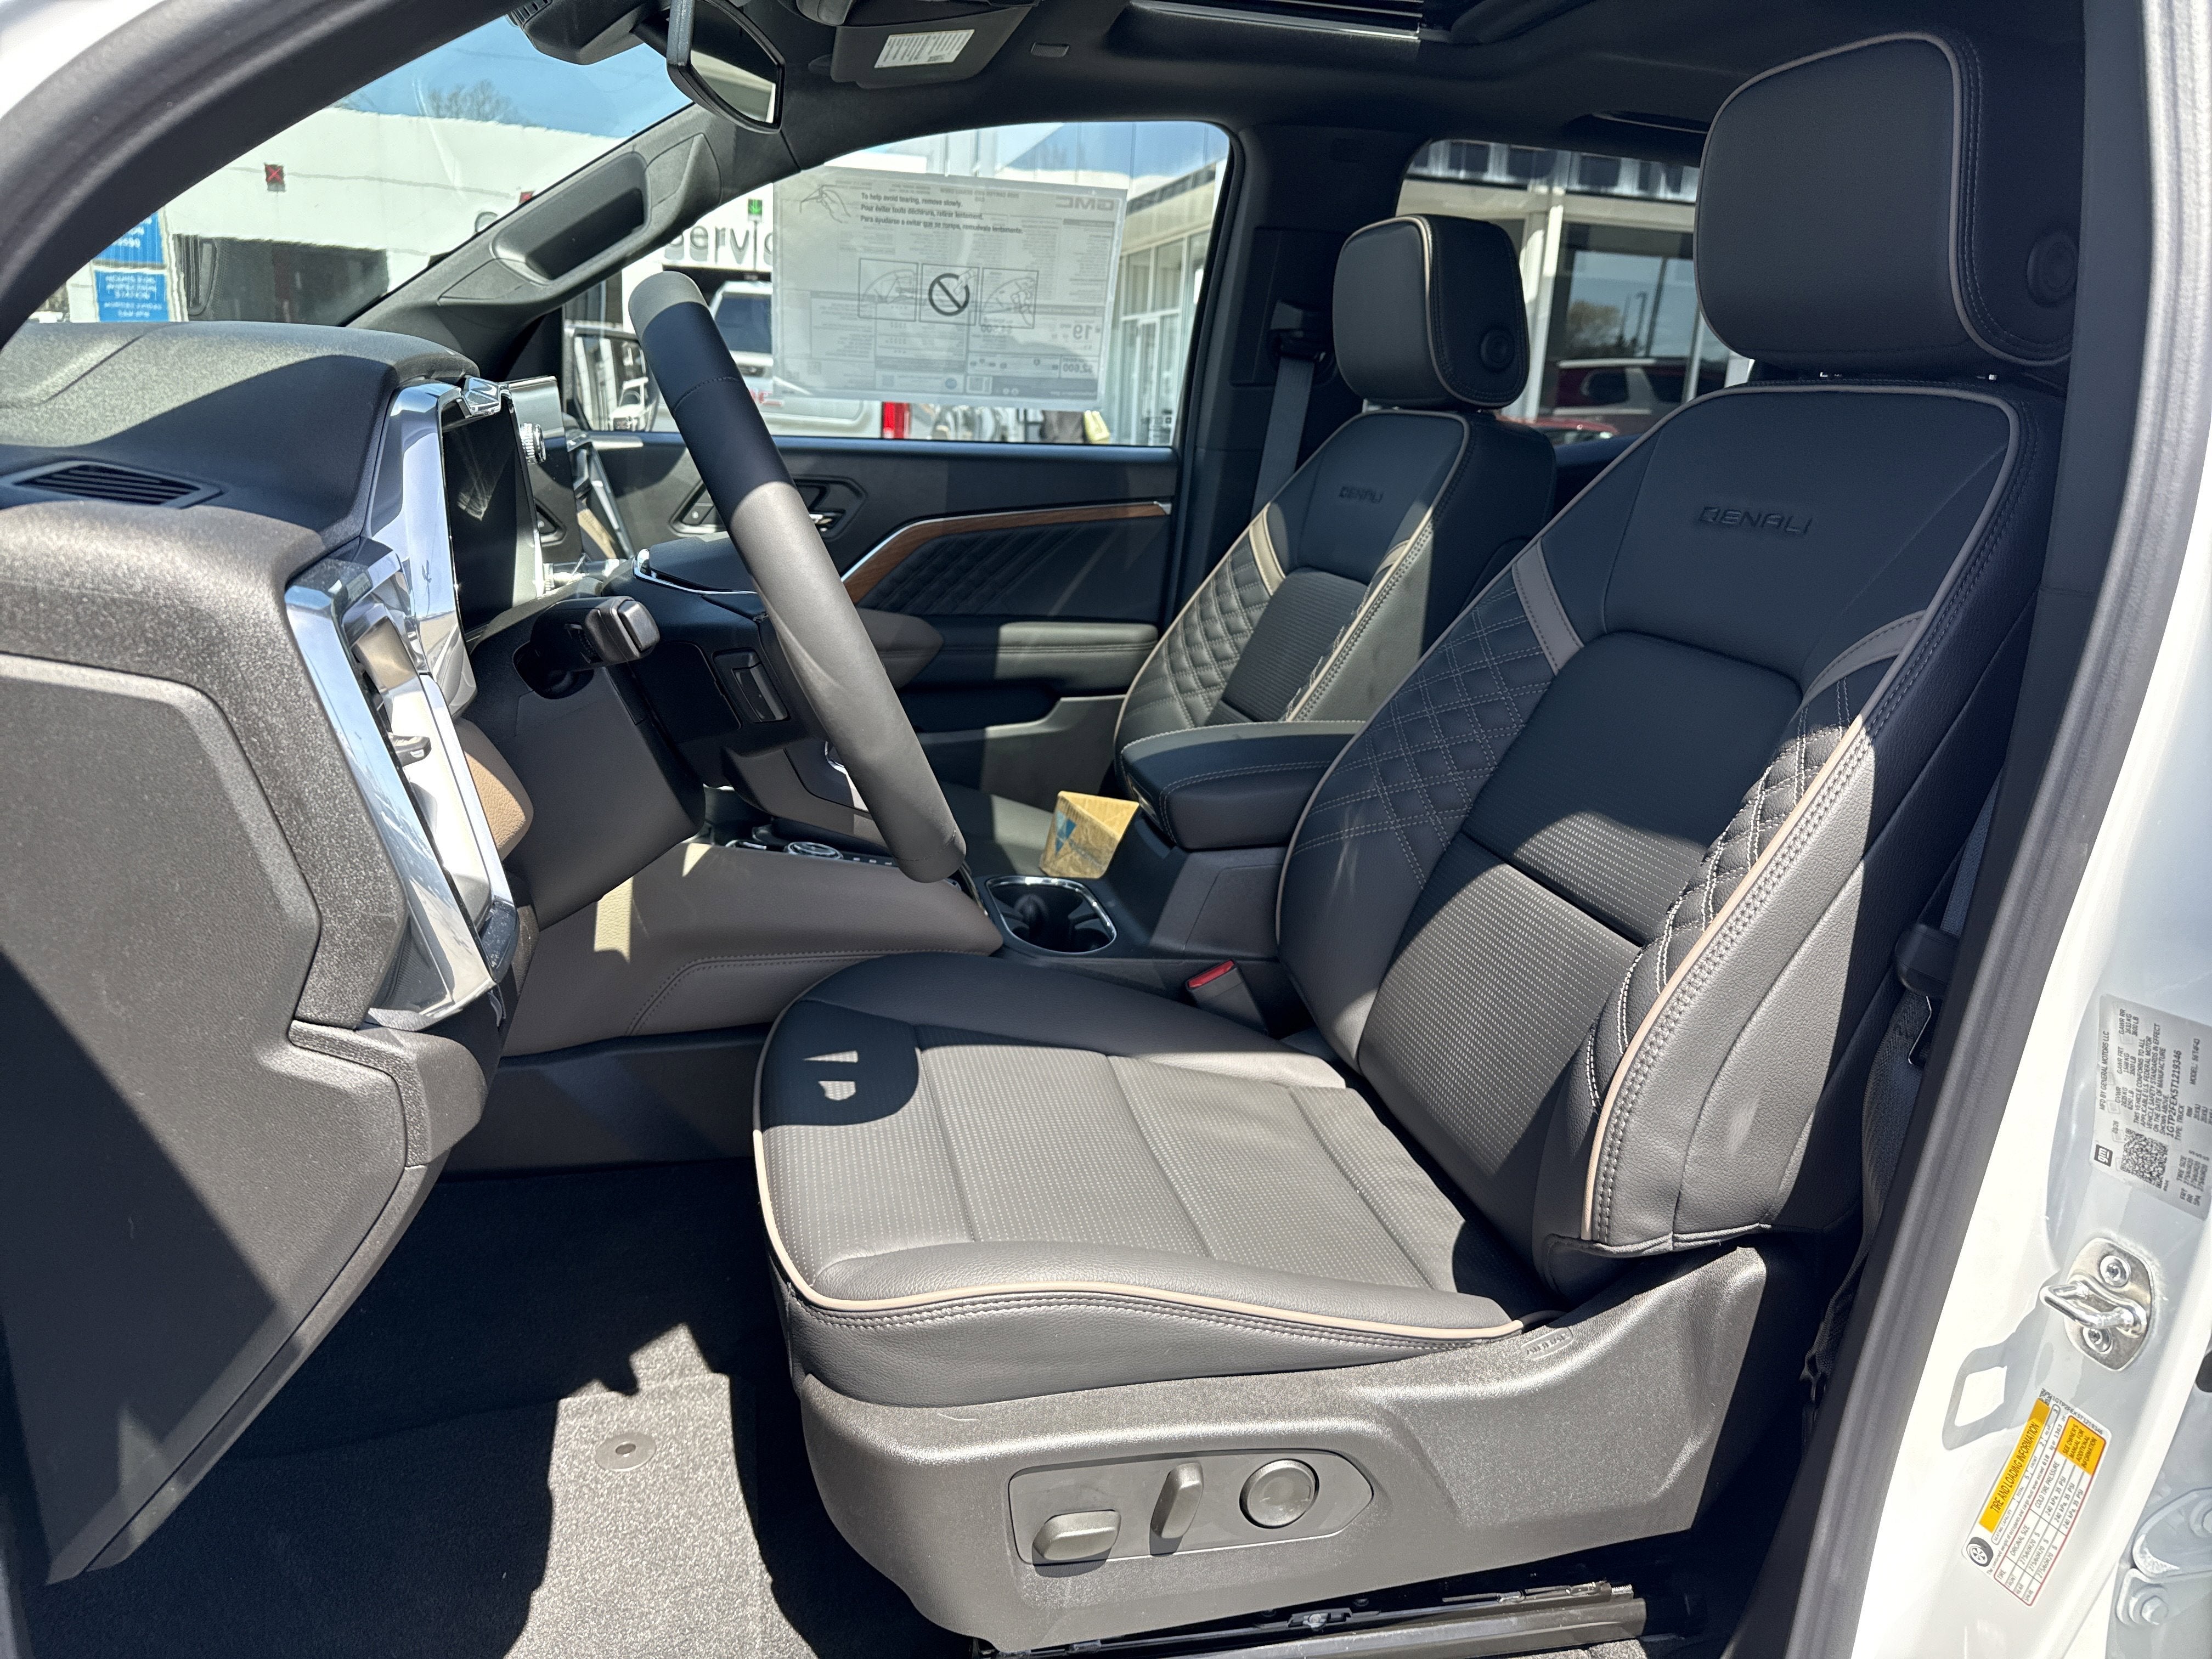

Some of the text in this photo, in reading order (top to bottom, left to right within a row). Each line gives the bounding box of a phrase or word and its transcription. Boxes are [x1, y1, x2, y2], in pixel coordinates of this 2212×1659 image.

[870, 193, 882, 202] help
[1698, 505, 1813, 535] DENALI
[2119, 1008, 2125, 1018] RR
[2125, 1012, 2132, 1022] KG
[2132, 1015, 2138, 1024] LB
[2123, 1052, 2130, 1062] KG
[2129, 1055, 2136, 1064] LB
[2137, 1048, 2145, 1057] TO
[2149, 1051, 2158, 1085] STANDARDS
[2156, 1046, 2166, 1088] MANUFACTURE
[2100, 1090, 2106, 1099] BY
[2155, 1087, 2162, 1097] OF
[2140, 1092, 2148, 1127] APPLICABLE
[2146, 1105, 2154, 1130] VEHICLE
[2176, 1103, 2185, 1124] TRUCK
[2152, 1122, 2159, 1132] ON
[2097, 1146, 2109, 1165] gm
[2052, 1423, 2063, 1439] 1363
[2062, 1443, 2070, 1455] SEE
[2068, 1427, 2085, 1459] MANUAL FOR
[2075, 1434, 2090, 1463] ADDITIONAL
[2080, 1436, 2097, 1469] INFORMATION
[1989, 1420, 2040, 1515] TIRE AND LOADING INFORMATION
[2044, 1504, 2053, 1516] 240
[2057, 1475, 2067, 1487] PSI
[2053, 1511, 2062, 1523] 240
[2066, 1481, 2075, 1493] PSI
[2061, 1517, 2071, 1530] 240
[2075, 1487, 2084, 1499] PSI
[1996, 1459, 2061, 1581] TIRE ORIGINAL SIZE COLD TIRE PRESSURE
